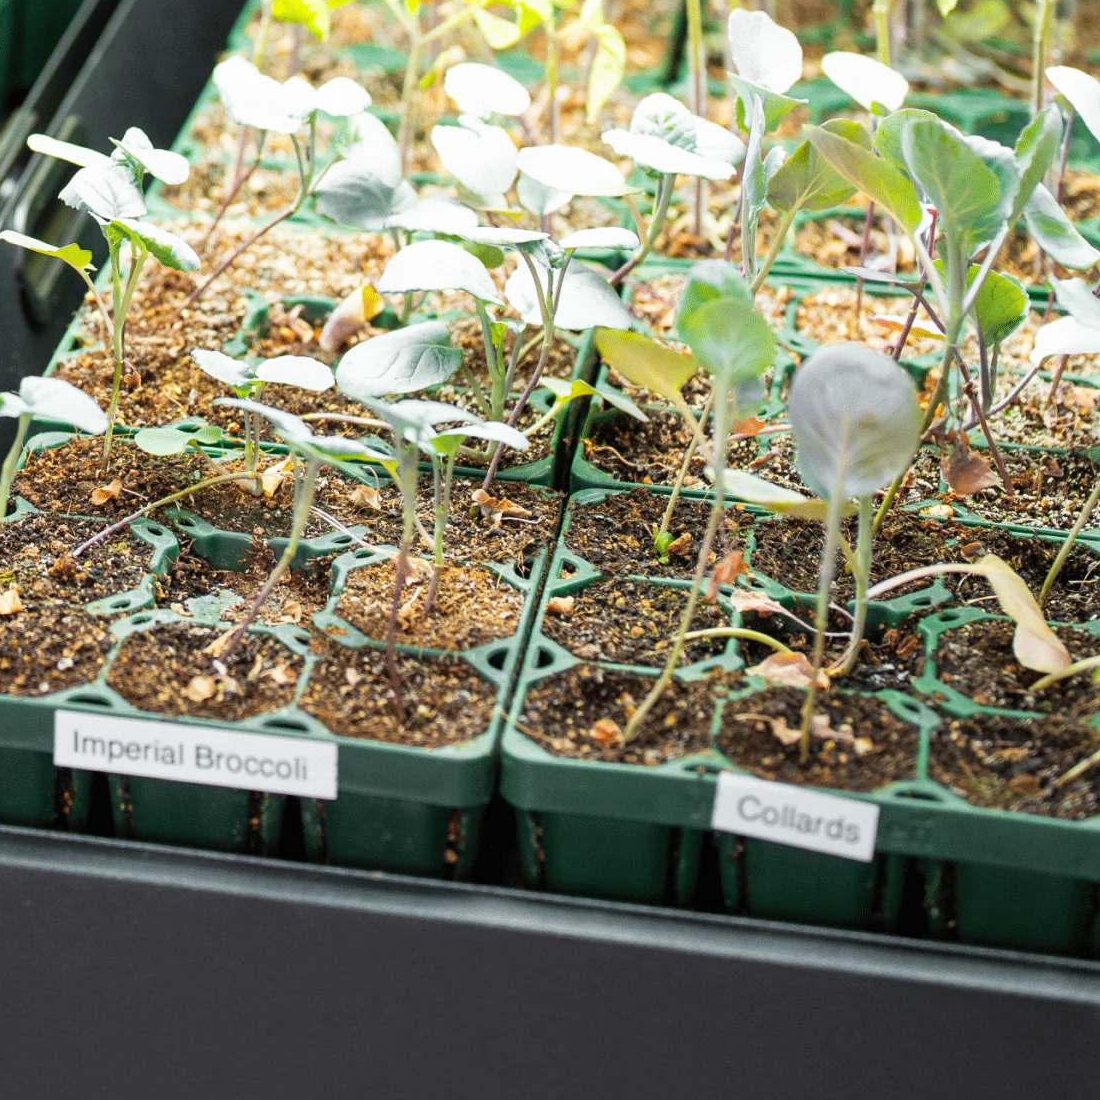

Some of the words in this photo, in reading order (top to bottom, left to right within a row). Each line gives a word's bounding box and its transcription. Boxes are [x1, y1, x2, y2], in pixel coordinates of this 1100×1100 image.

[72, 730, 185, 766] Imperial
[195, 744, 308, 781] Broccoli
[737, 794, 861, 845] Collards
